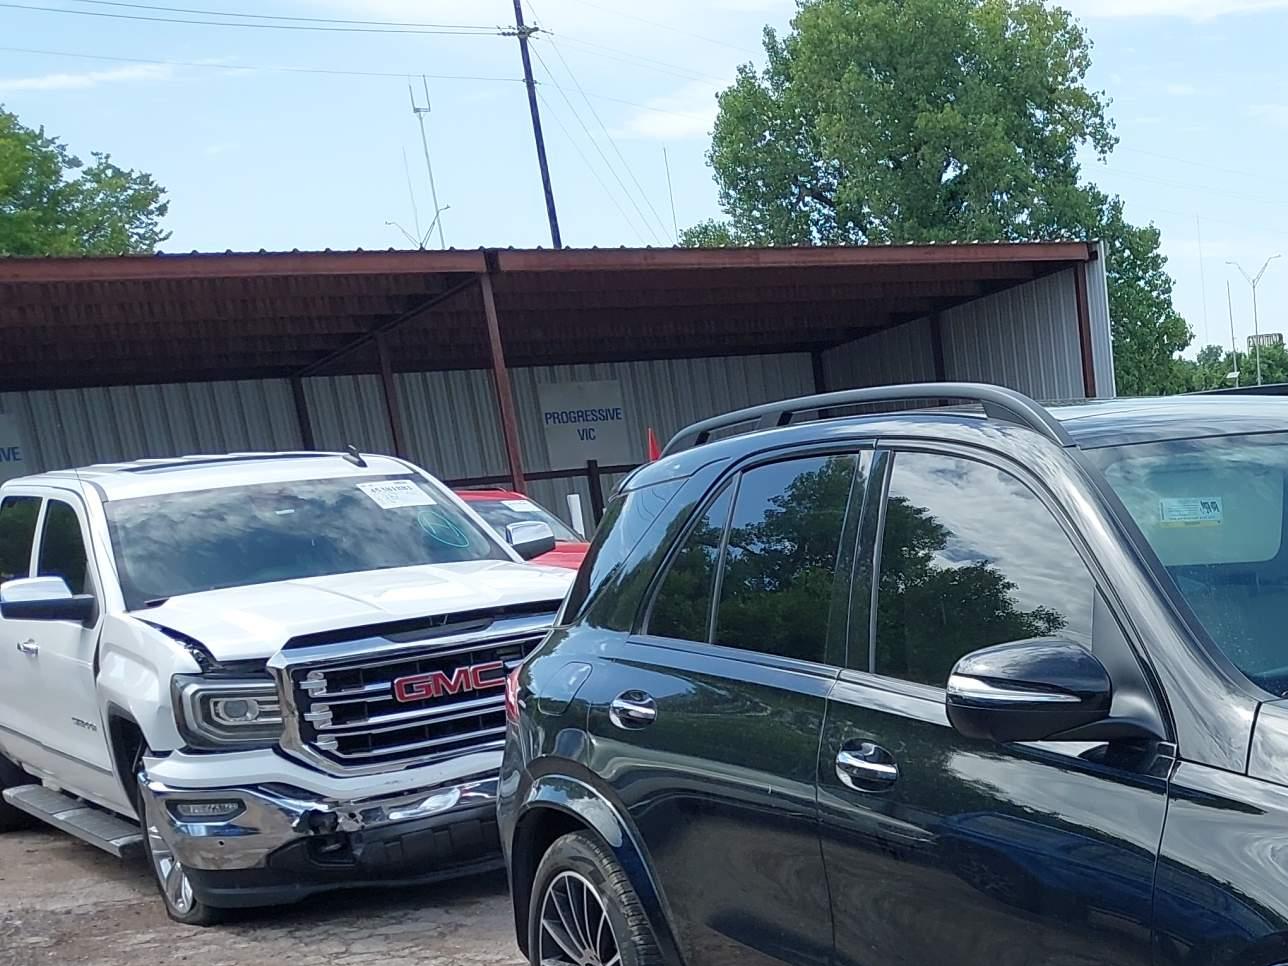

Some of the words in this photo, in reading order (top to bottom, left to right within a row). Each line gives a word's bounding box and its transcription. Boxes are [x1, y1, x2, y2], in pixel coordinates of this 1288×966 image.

[544, 407, 622, 425] PROGRESSIVE
[577, 427, 597, 441] VIC
[394, 661, 506, 703] GMC
